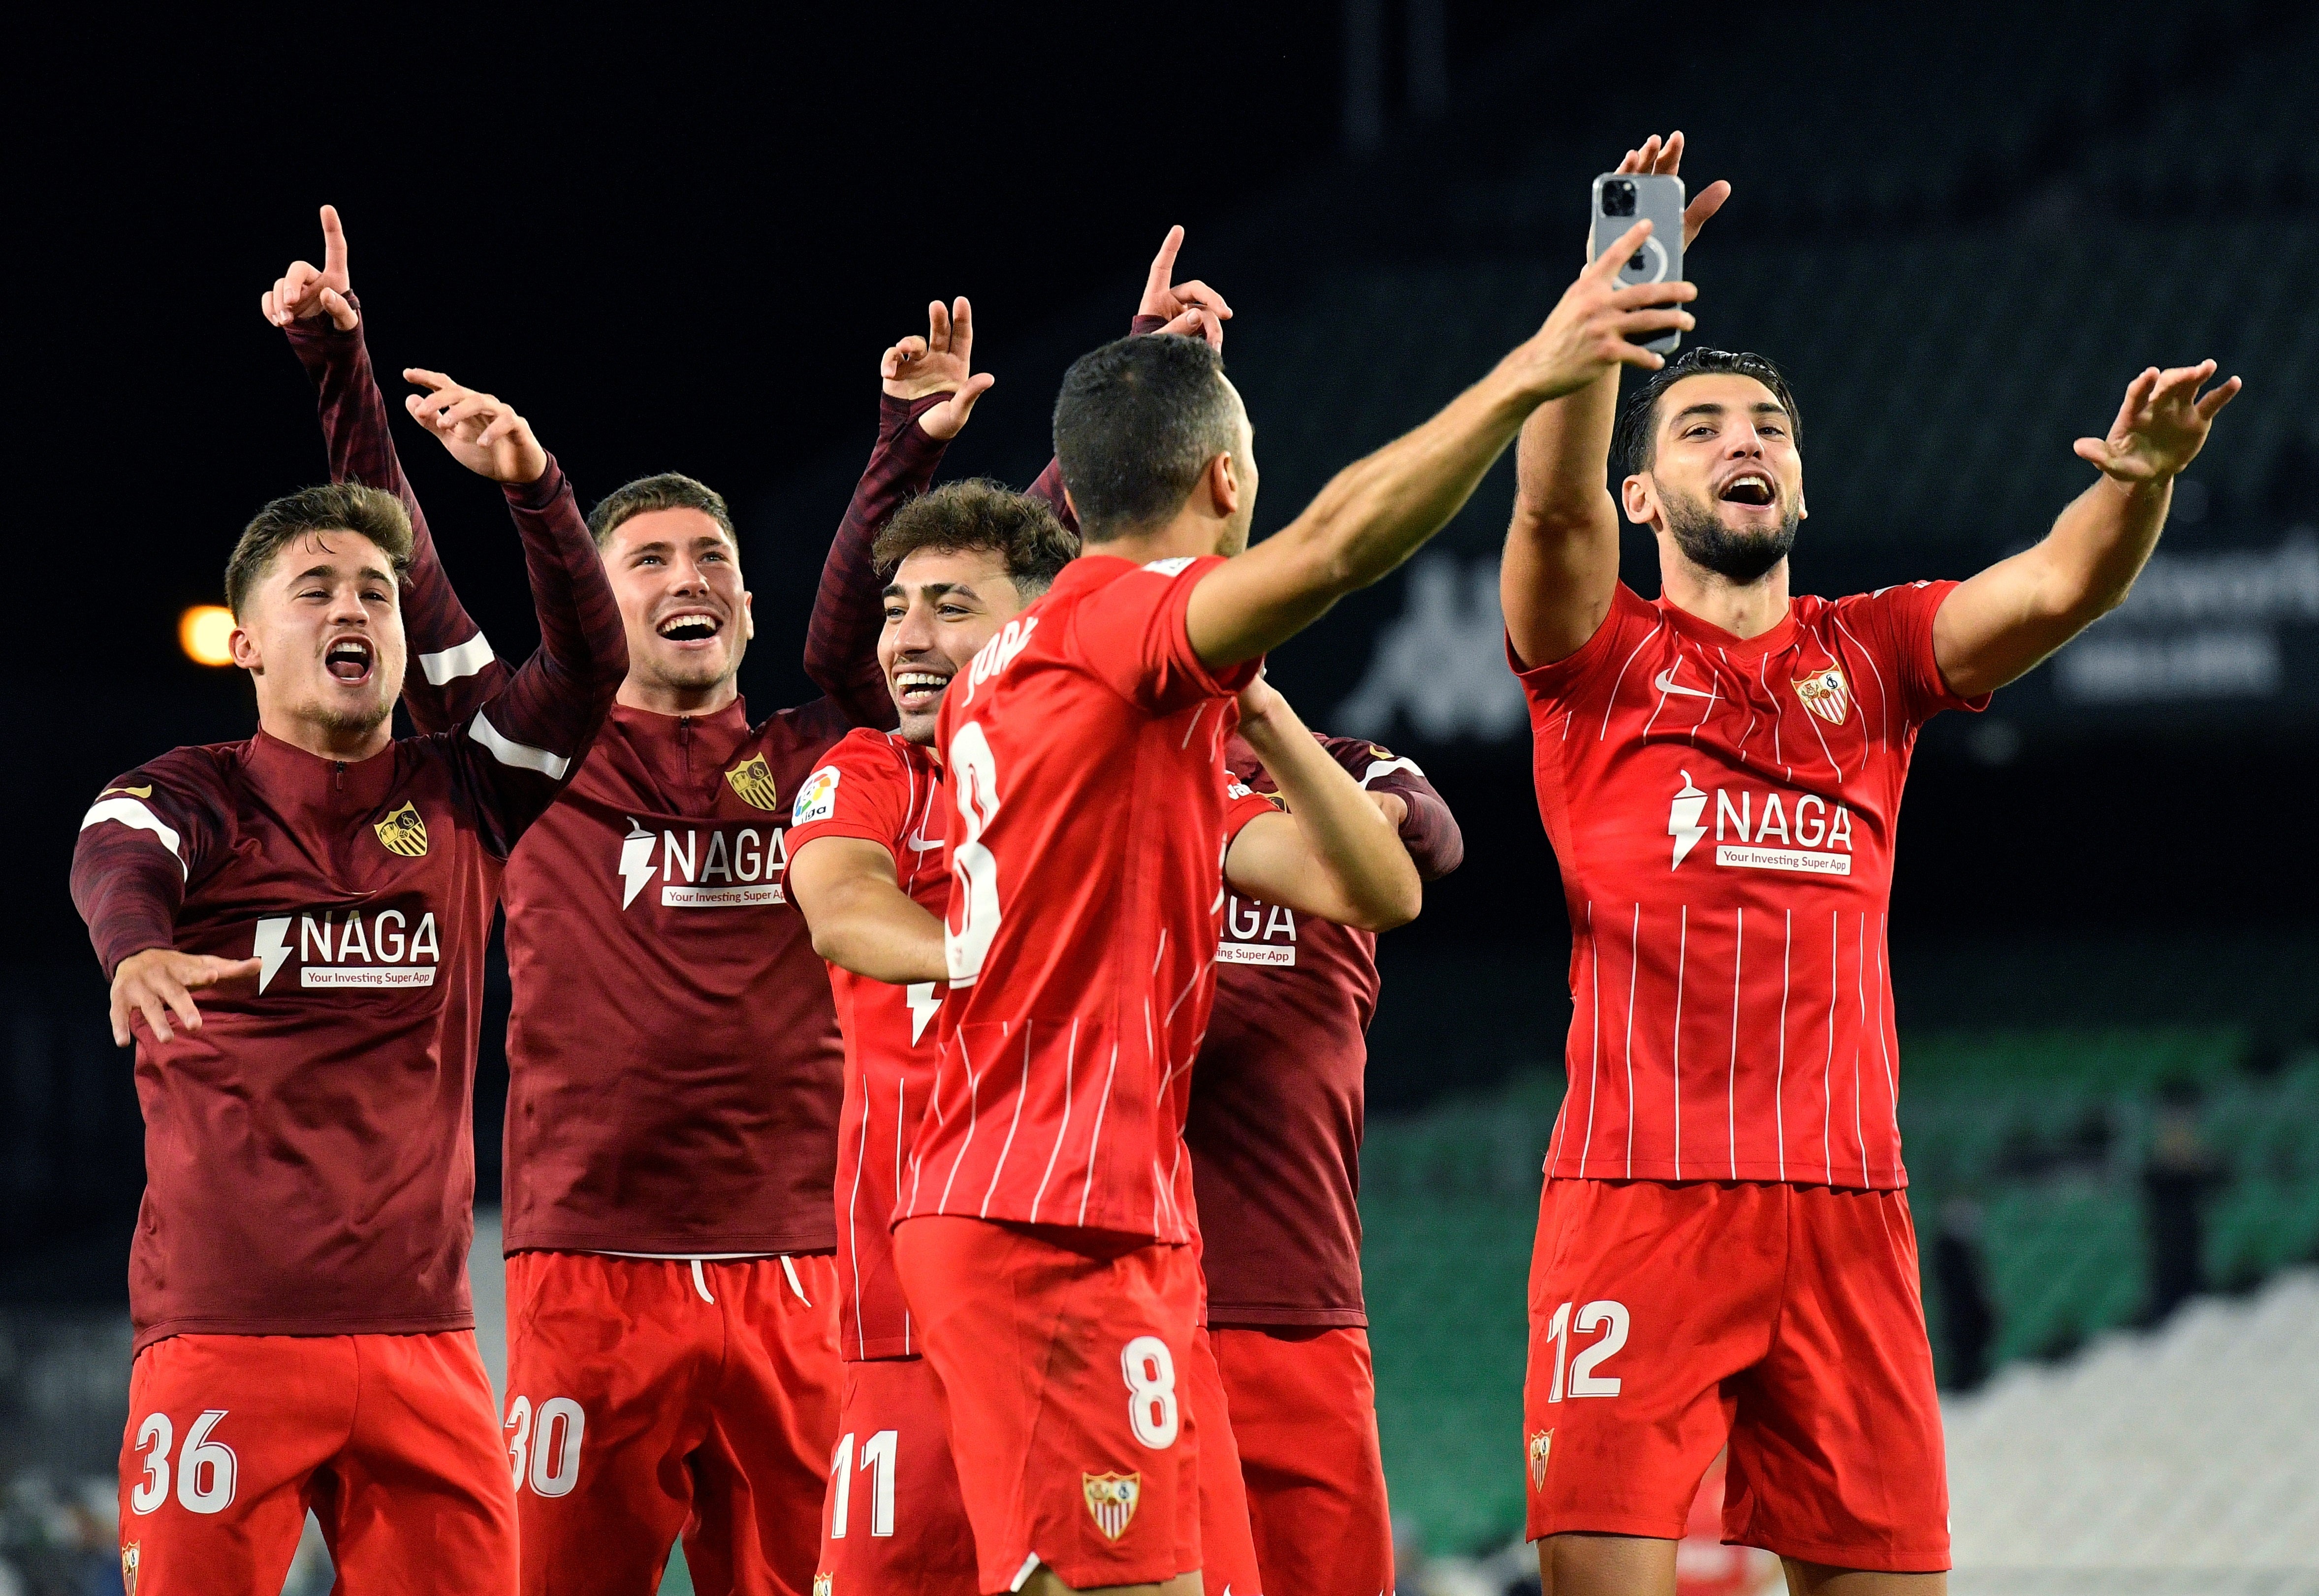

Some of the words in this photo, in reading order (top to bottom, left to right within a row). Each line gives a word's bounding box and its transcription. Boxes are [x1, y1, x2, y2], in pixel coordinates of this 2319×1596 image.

[1716, 789, 1852, 851] NAGA
[663, 828, 788, 882] NAGA
[1724, 851, 1748, 862] Your
[1752, 853, 1799, 867] Investing
[1802, 857, 1829, 869] Super
[1830, 859, 1846, 871] App
[669, 892, 693, 901] Your
[696, 892, 741, 902] Investing
[744, 891, 771, 902] Super
[1219, 895, 1297, 941] GA
[301, 910, 440, 962] NAGA
[1216, 947, 1233, 959] ing
[1236, 949, 1266, 960] Super
[1267, 951, 1289, 962] App
[308, 972, 332, 982] Your
[335, 972, 382, 985] Investing
[385, 972, 412, 984] Super
[413, 972, 430, 983] App
[1547, 1300, 1630, 1403] 12
[1120, 1336, 1178, 1449] 8
[131, 1409, 238, 1516] 36
[505, 1395, 585, 1498] 30
[831, 1430, 898, 1539] 11
